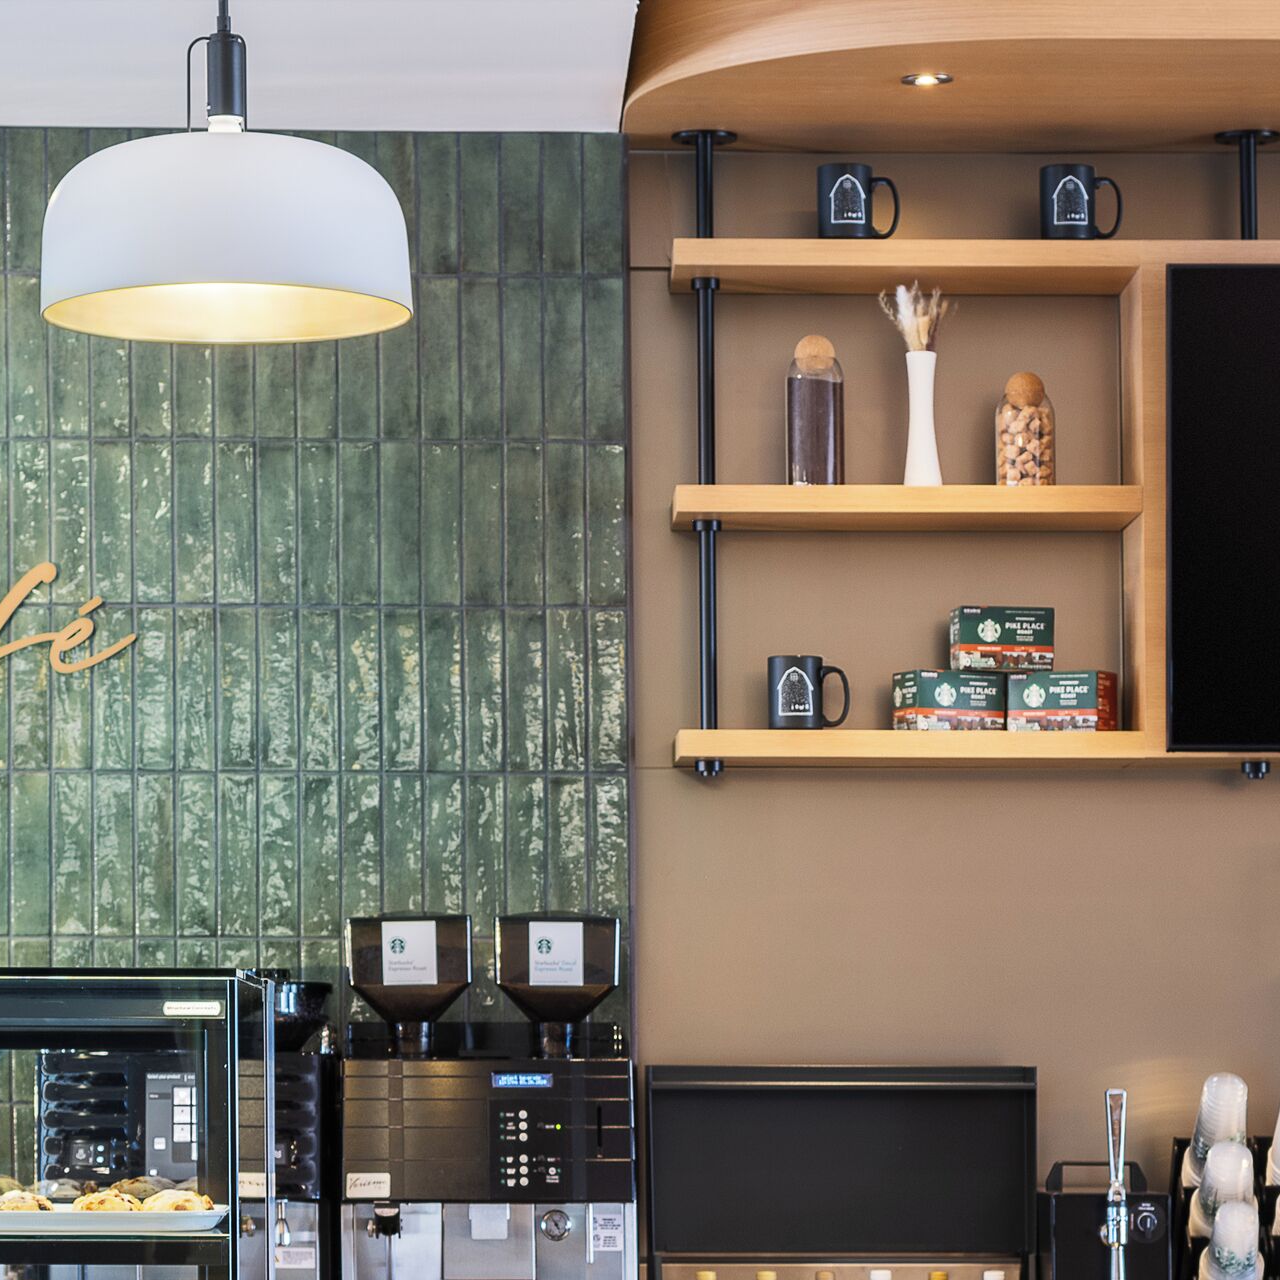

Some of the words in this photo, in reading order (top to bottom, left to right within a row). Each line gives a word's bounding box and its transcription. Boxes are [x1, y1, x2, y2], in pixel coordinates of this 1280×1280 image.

[1022, 622, 1045, 630] PLACE
[960, 686, 975, 694] PIKE
[976, 687, 997, 695] PLACE
[1049, 686, 1065, 694] PIKE
[1066, 685, 1088, 693] PLACE
